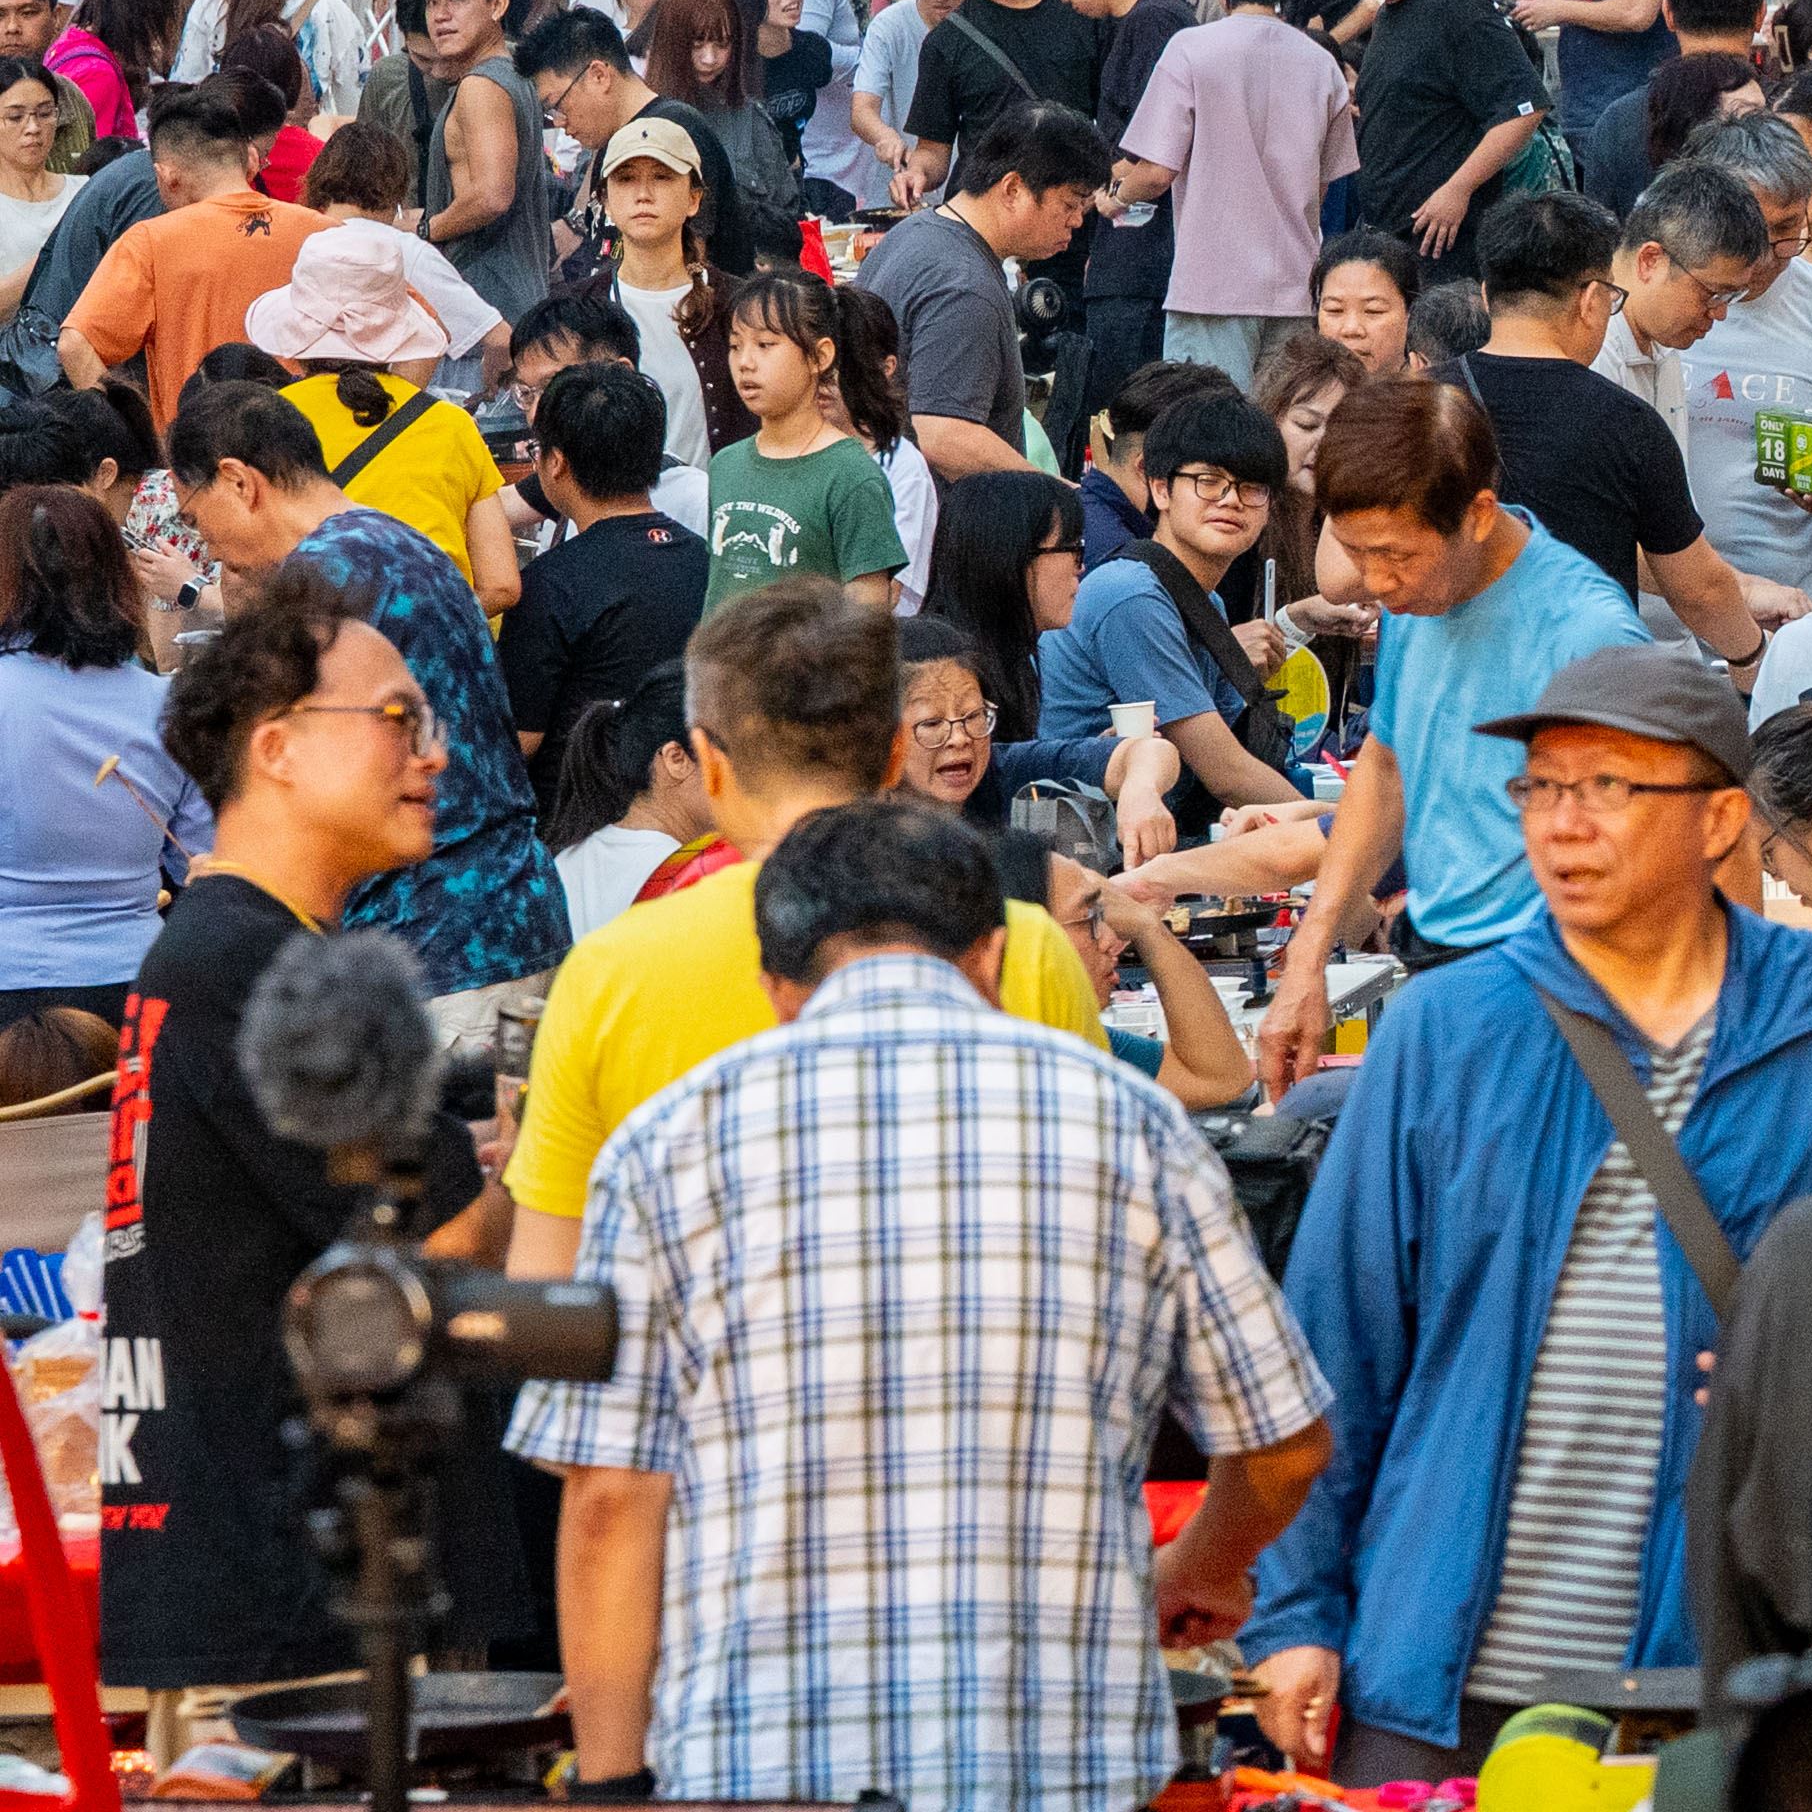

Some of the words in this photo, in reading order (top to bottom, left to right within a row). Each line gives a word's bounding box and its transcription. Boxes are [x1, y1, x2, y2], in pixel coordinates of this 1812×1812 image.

[1760, 419, 1785, 434] ONLY
[1761, 437, 1786, 463] 18
[1762, 467, 1786, 480] DAYS
